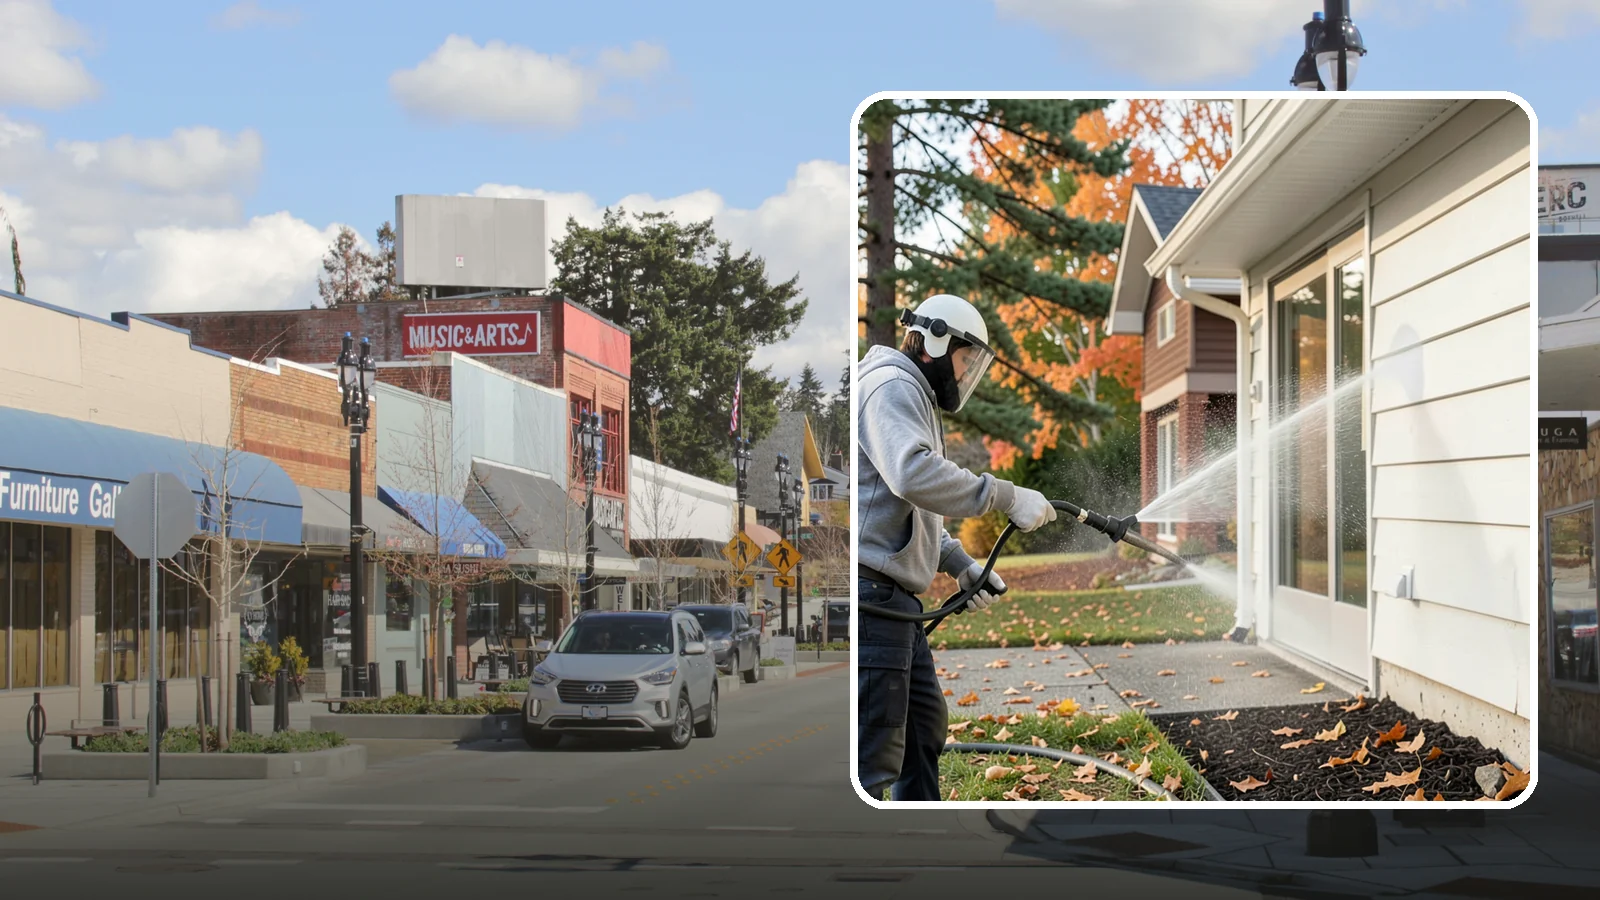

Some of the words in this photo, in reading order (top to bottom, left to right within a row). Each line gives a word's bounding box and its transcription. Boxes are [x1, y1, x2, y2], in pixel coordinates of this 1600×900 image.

[409, 323, 520, 349] MUSIC&ARTS
[0, 472, 79, 515] Furniture
[90, 482, 122, 519] Gal
